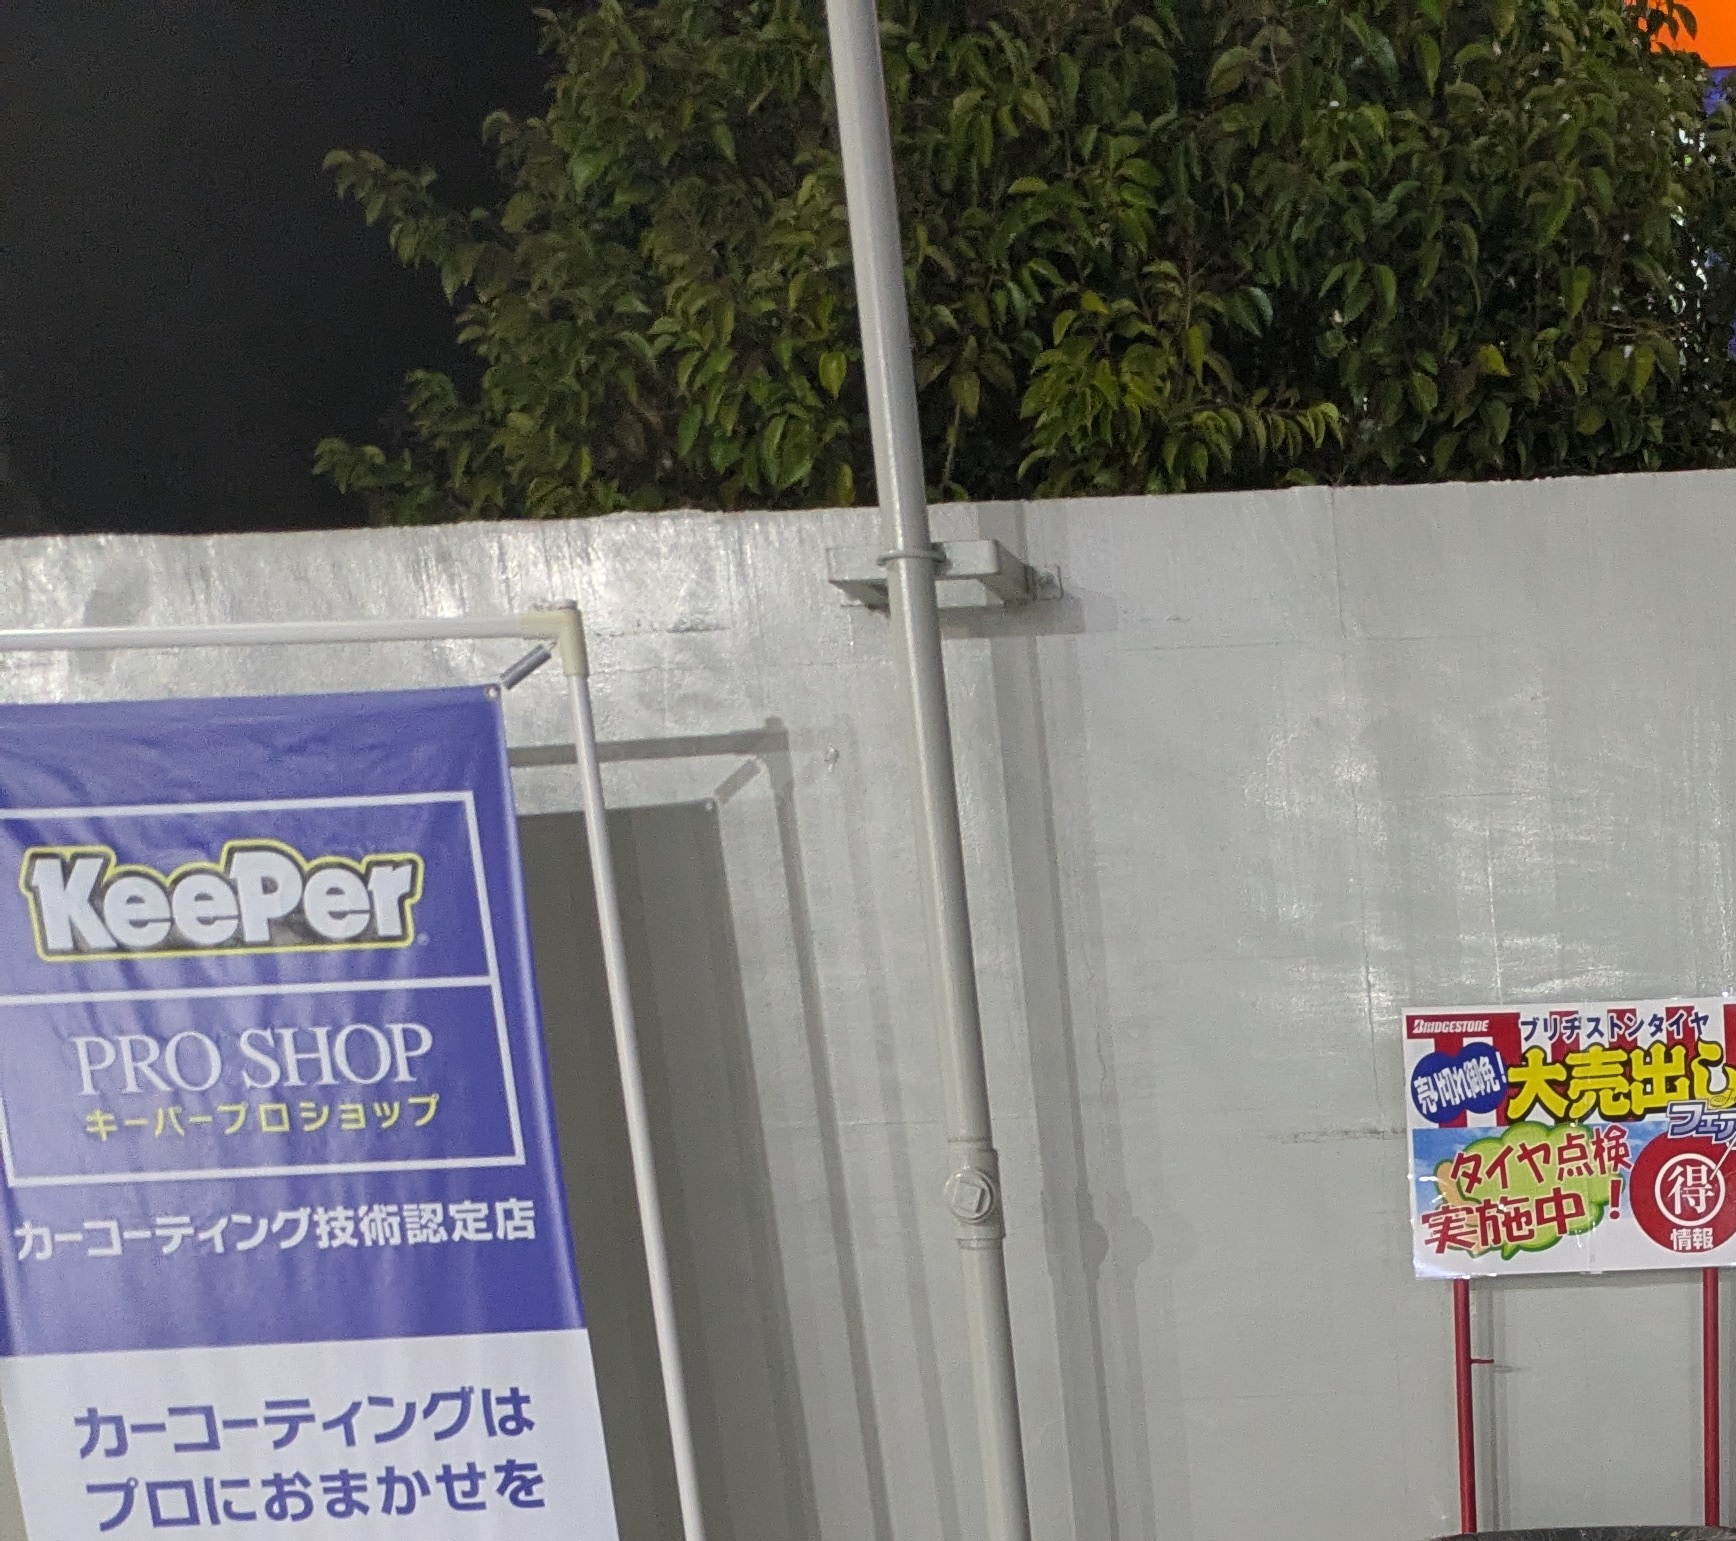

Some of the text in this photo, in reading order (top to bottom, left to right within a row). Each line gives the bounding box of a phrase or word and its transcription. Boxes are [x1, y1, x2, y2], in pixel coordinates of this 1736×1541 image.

[30, 845, 420, 953] KeePer
[1412, 1019, 1490, 1034] BRIDGESTONE
[1520, 1011, 1710, 1043] ブリヂストンタイヤ
[73, 1021, 436, 1100] PRO SHOP
[1450, 1124, 1634, 1193] タイヤ点検
[1665, 1163, 1714, 1217] 得
[14, 1198, 538, 1263] カーコーティング技術認定店
[1670, 1227, 1714, 1251] 情報
[73, 1386, 537, 1461] カーコーティングは
[86, 1457, 547, 1534] プロにおまかせを
